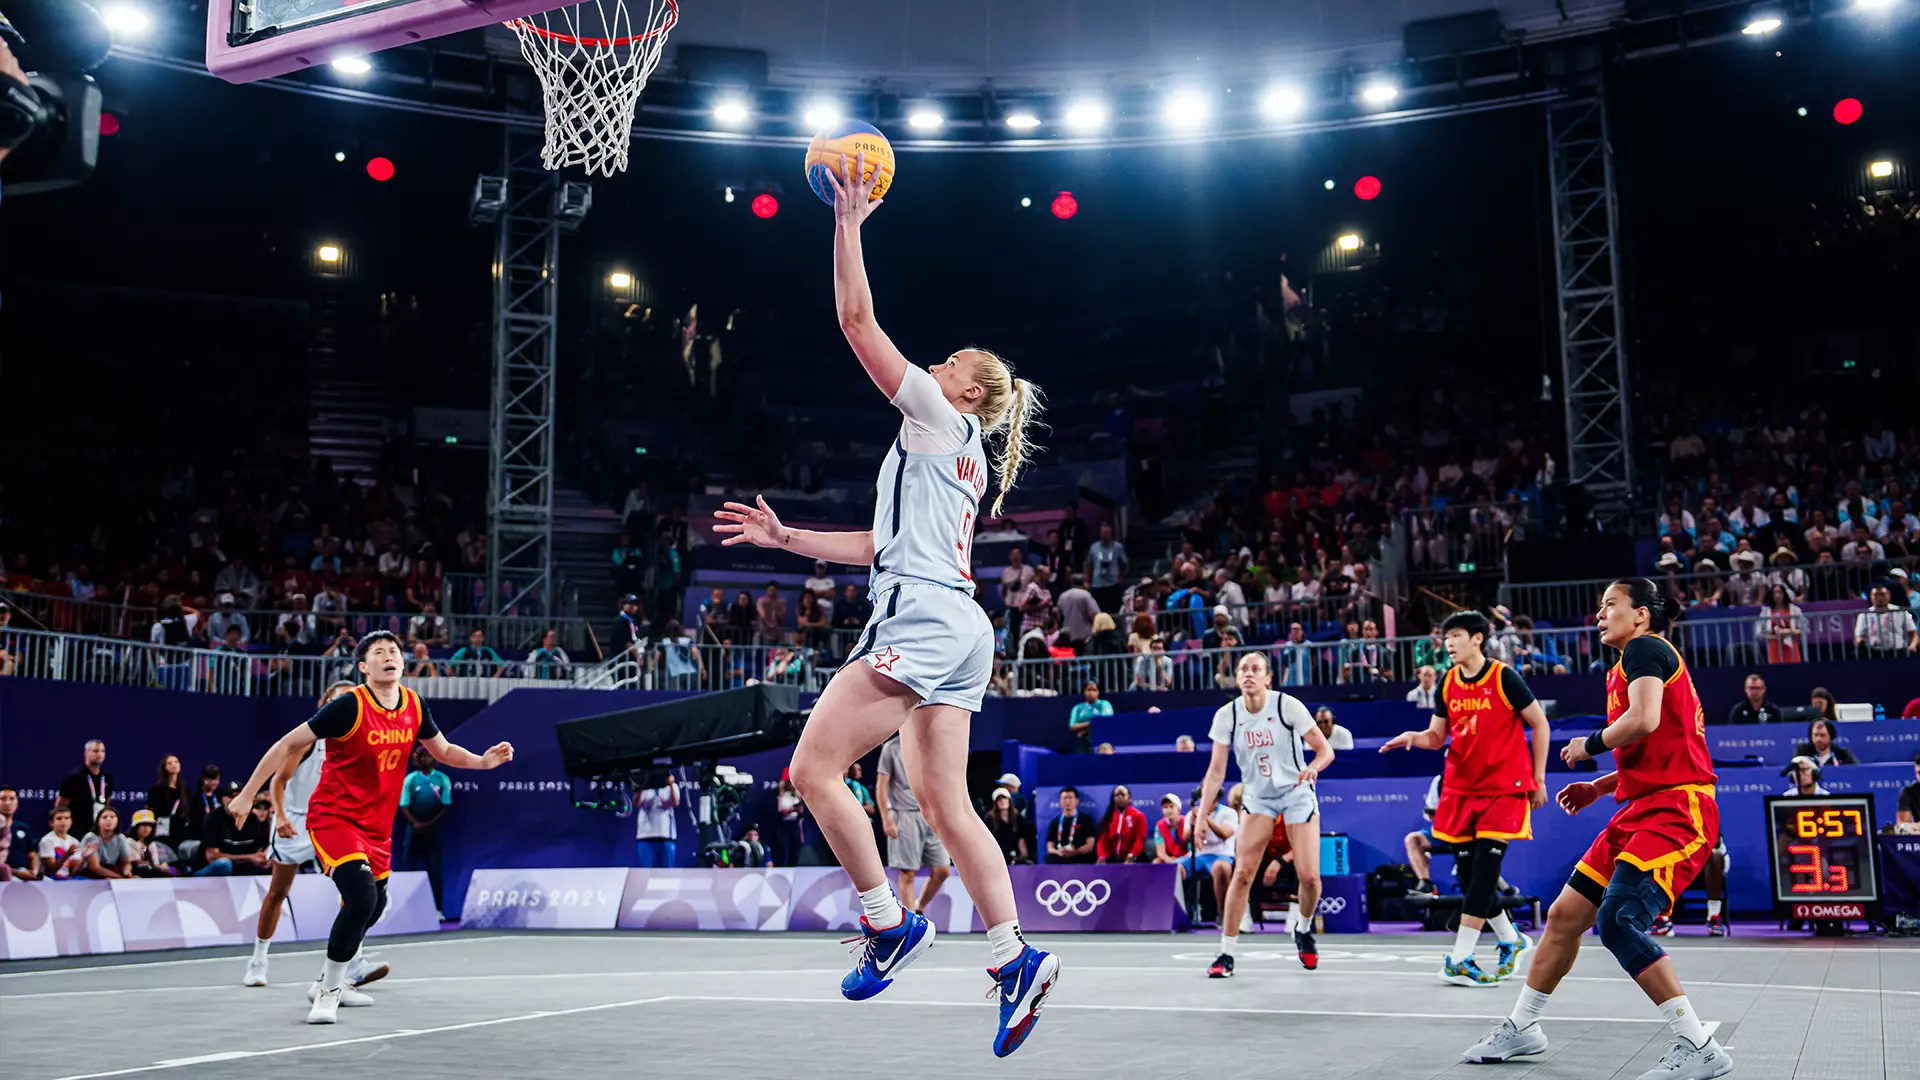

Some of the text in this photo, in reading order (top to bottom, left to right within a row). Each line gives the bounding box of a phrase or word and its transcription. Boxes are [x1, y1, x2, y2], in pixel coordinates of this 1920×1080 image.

[855, 142, 885, 156] PARIS
[956, 456, 977, 482] VAN
[954, 496, 977, 581] 9
[1449, 697, 1492, 713] CHINA
[367, 727, 414, 746] CHINA
[1244, 728, 1275, 749] USA
[1866, 734, 1895, 744] PARIS
[378, 748, 402, 773] 10
[1255, 752, 1273, 778] 5
[499, 781, 571, 791] PARIS 2024
[1868, 779, 1902, 789] PARIS
[1797, 810, 1863, 838] 6:57
[1787, 845, 1848, 892] 3.3
[477, 889, 608, 907] PARIS 2024
[1811, 905, 1861, 918] OMEGA
